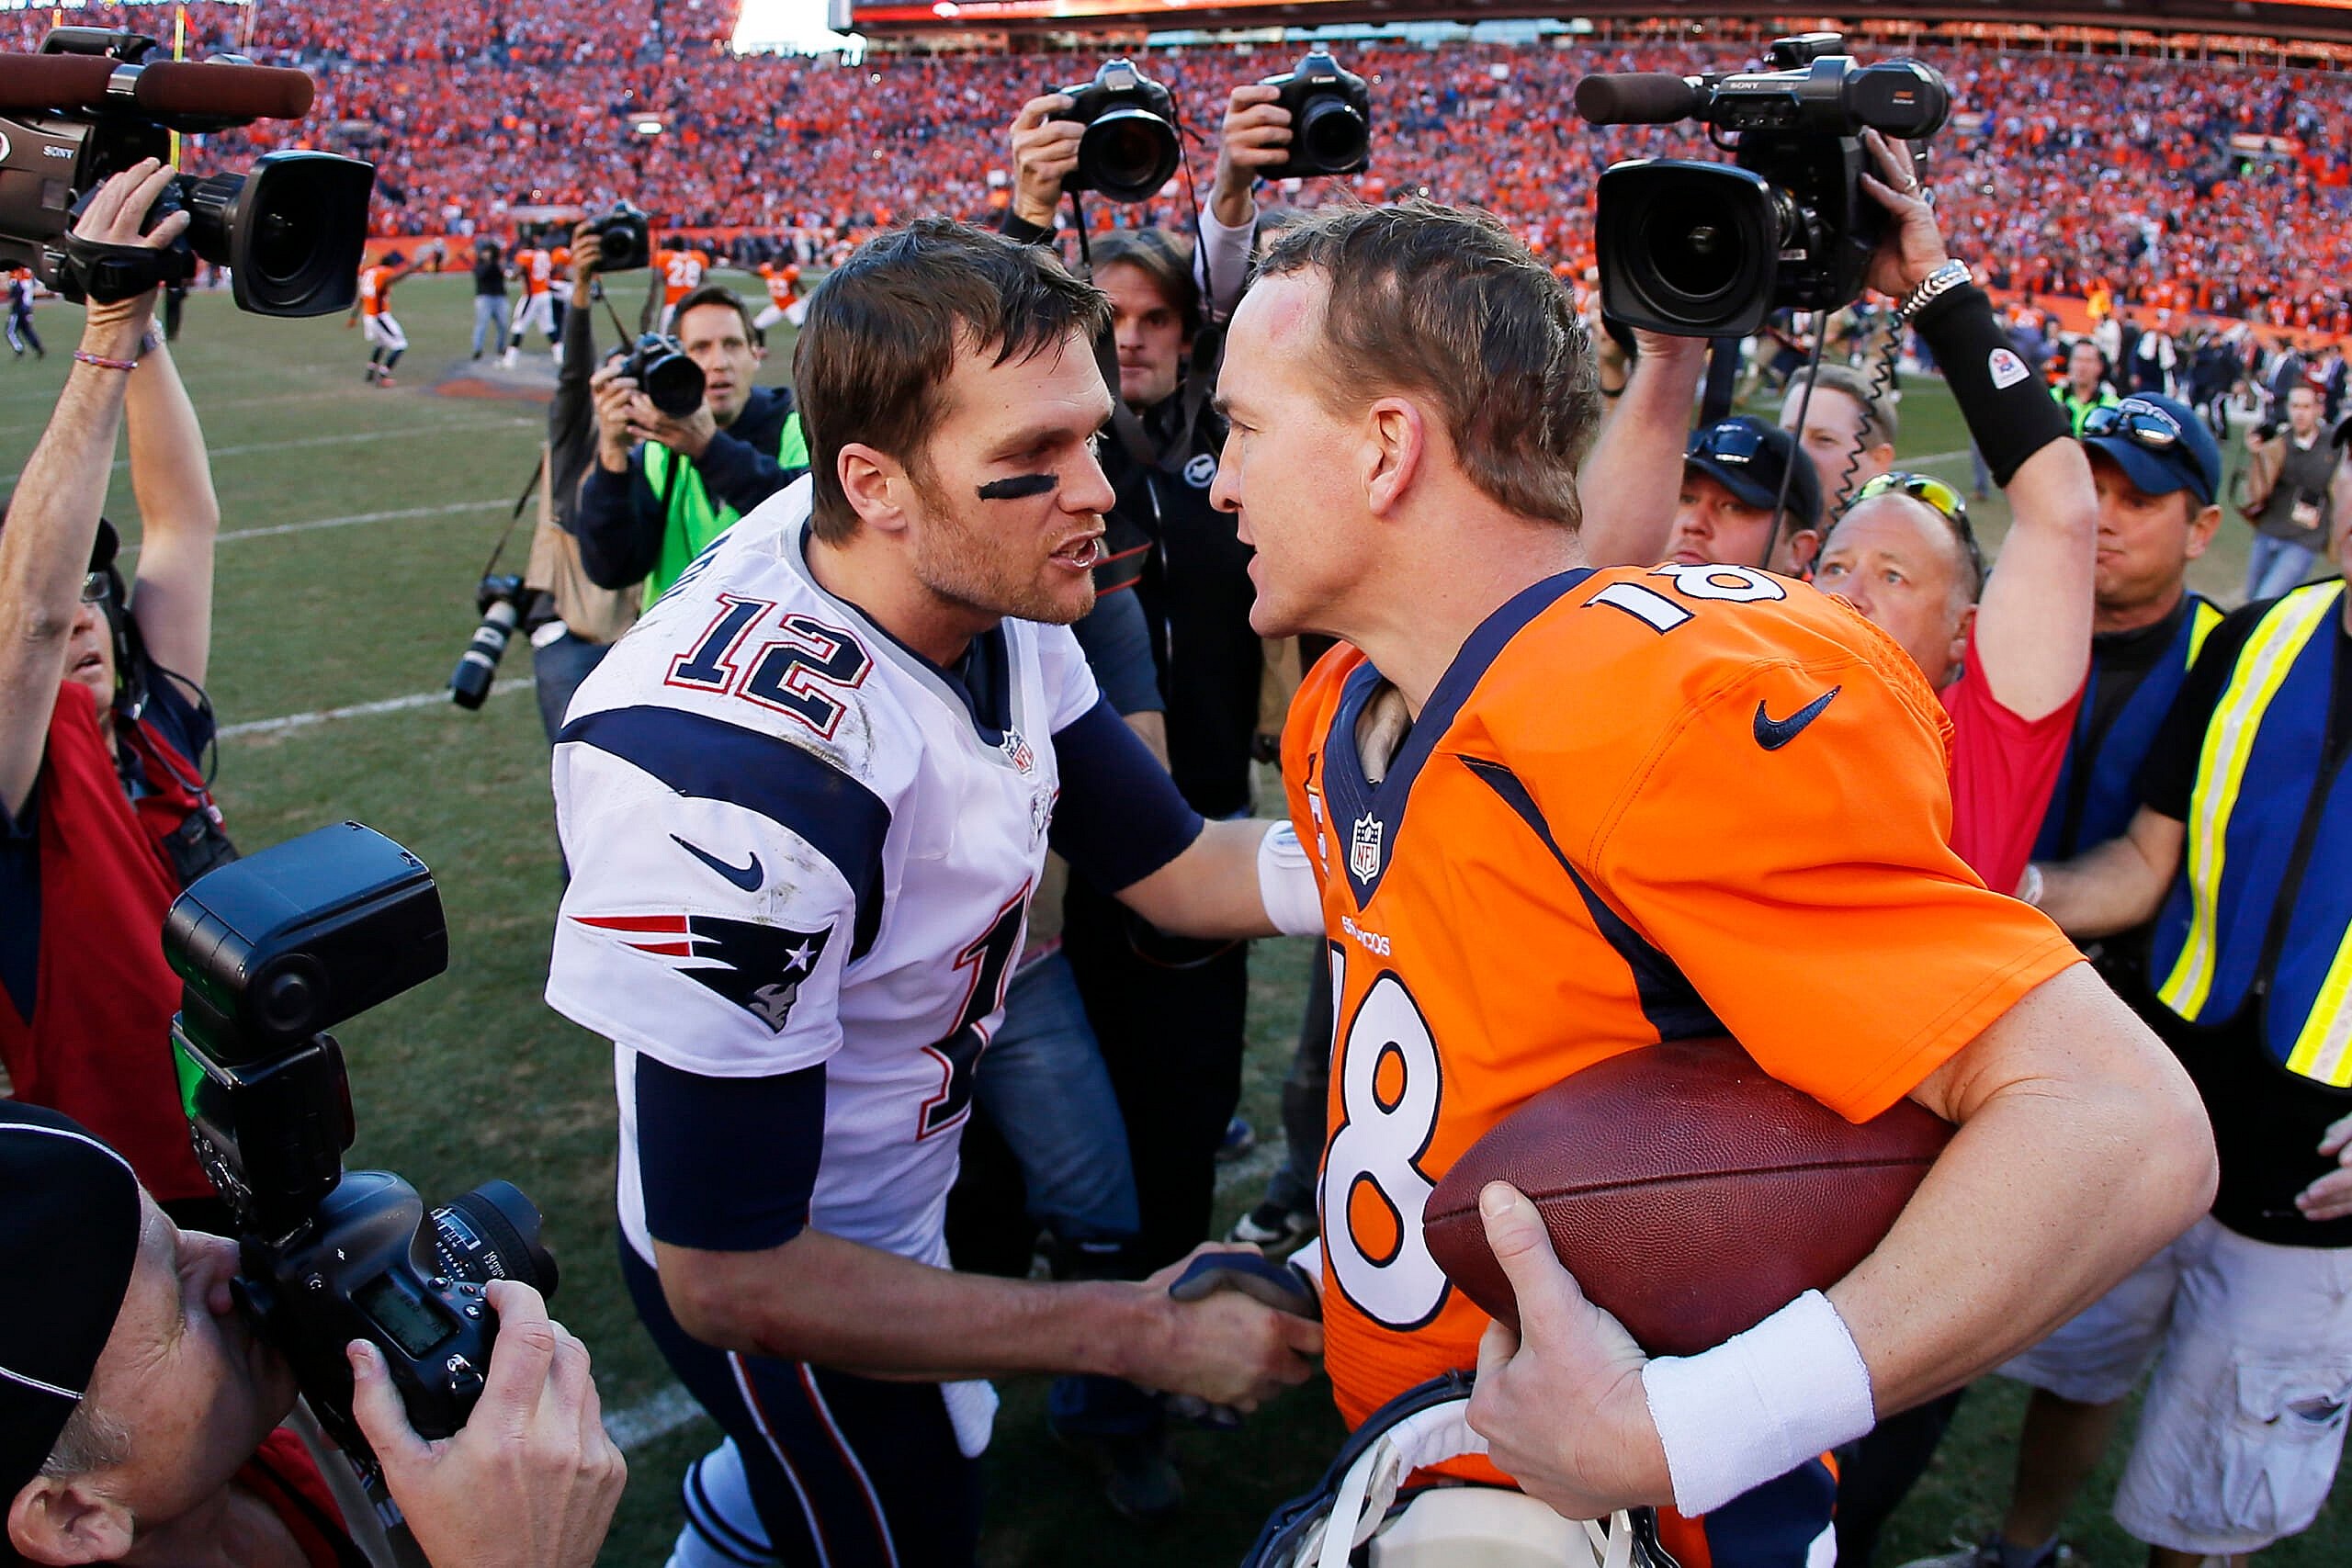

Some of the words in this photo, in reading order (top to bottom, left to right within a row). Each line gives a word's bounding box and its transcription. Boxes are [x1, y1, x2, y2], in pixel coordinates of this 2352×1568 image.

[42, 145, 74, 159] SONY
[663, 592, 875, 741] 12
[1013, 745, 1033, 771] NFL
[1355, 844, 1377, 871] NFL
[1341, 915, 1391, 956] BCOS
